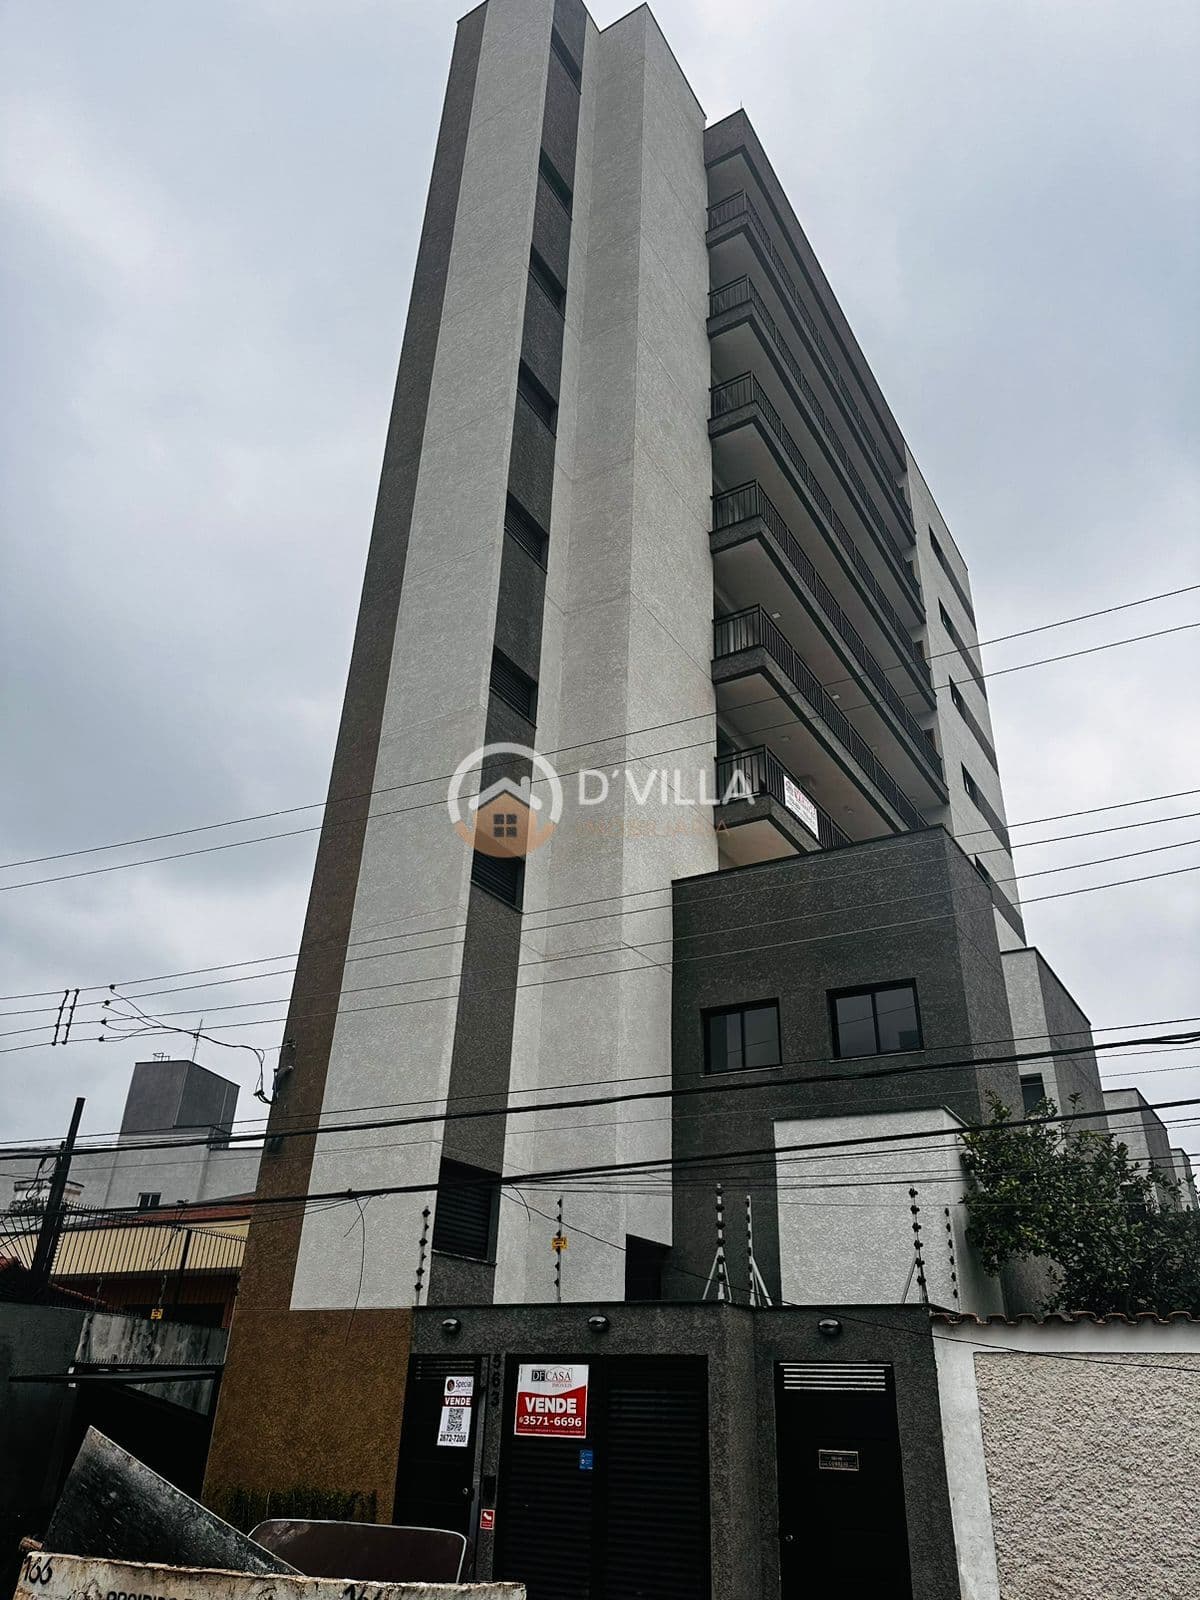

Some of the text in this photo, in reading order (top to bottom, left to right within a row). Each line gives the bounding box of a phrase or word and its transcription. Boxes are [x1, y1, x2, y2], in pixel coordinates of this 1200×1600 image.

[444, 1397, 471, 1405] VENDE
[525, 1397, 577, 1414] VENDE
[523, 1416, 582, 1427] 3571-6696
[24, 1555, 53, 1585] 166
